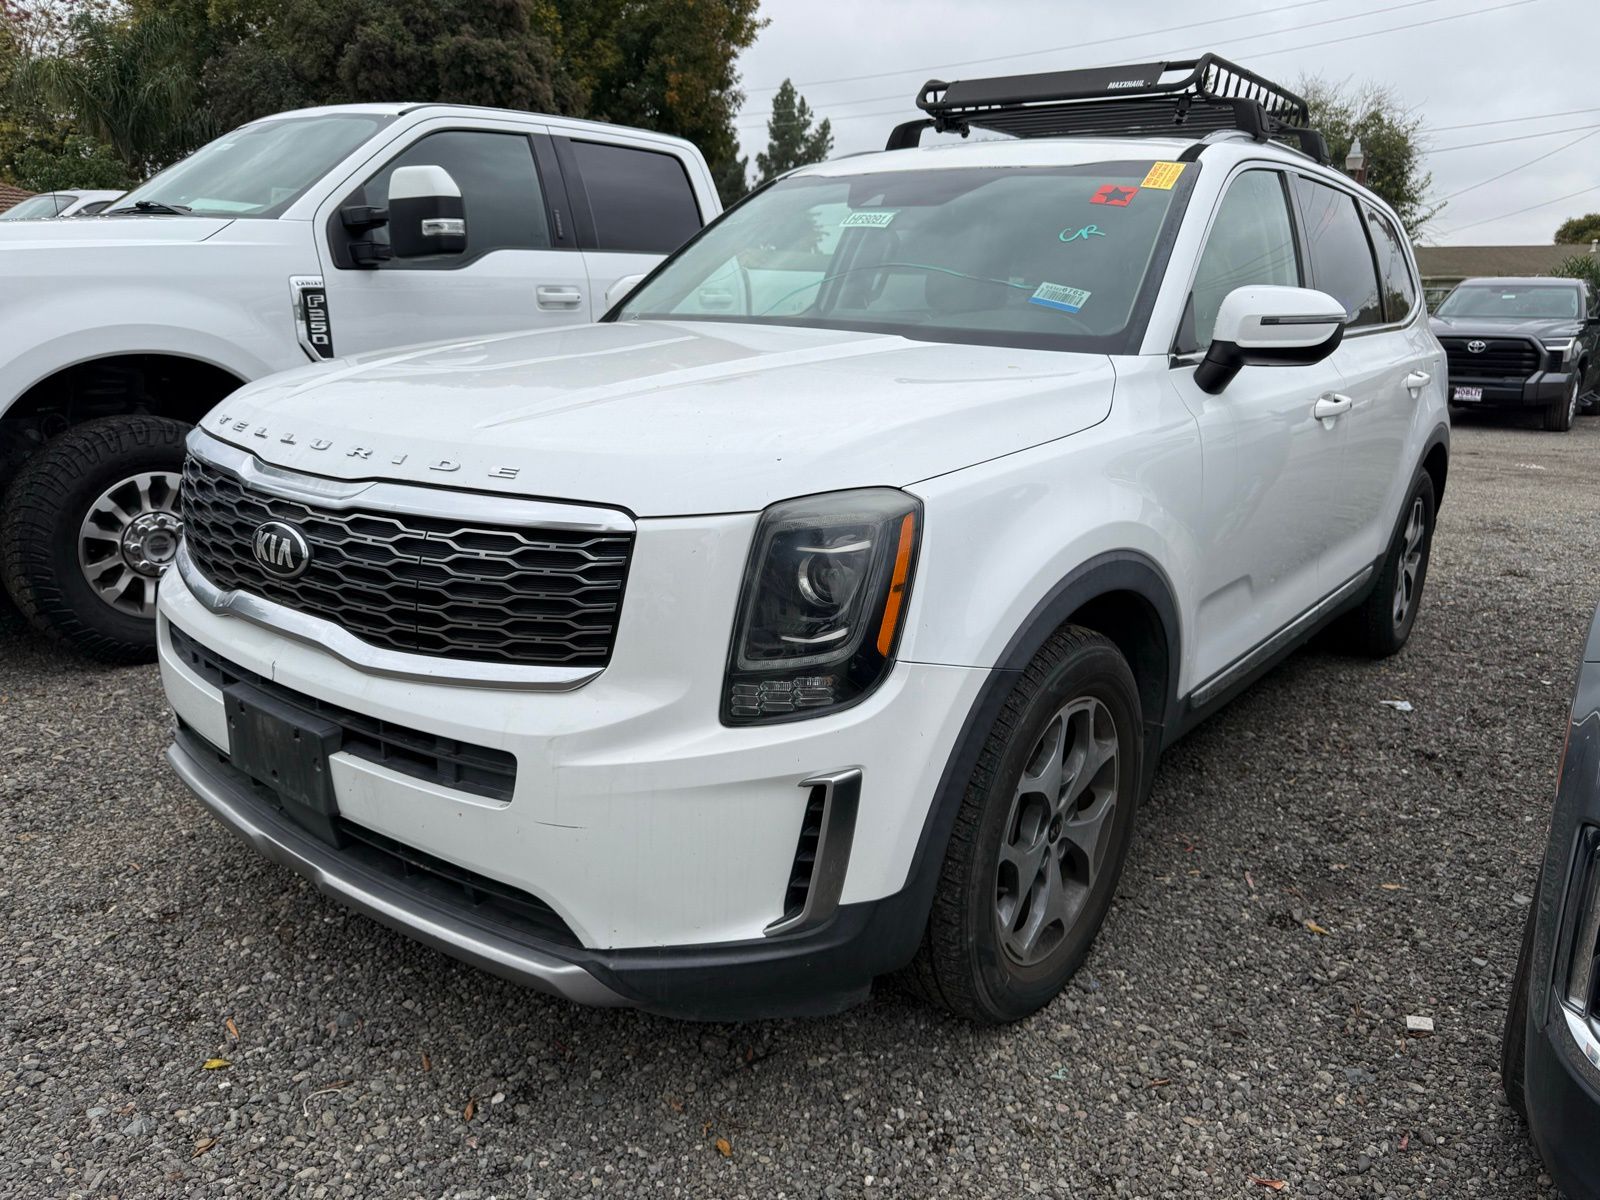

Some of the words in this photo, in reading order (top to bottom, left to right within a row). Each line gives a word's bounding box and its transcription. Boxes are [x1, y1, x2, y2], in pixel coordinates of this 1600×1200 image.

[1107, 80, 1145, 89] MAXXHAUL
[219, 414, 520, 479] TELLURIDE
[256, 530, 295, 569] KIA
